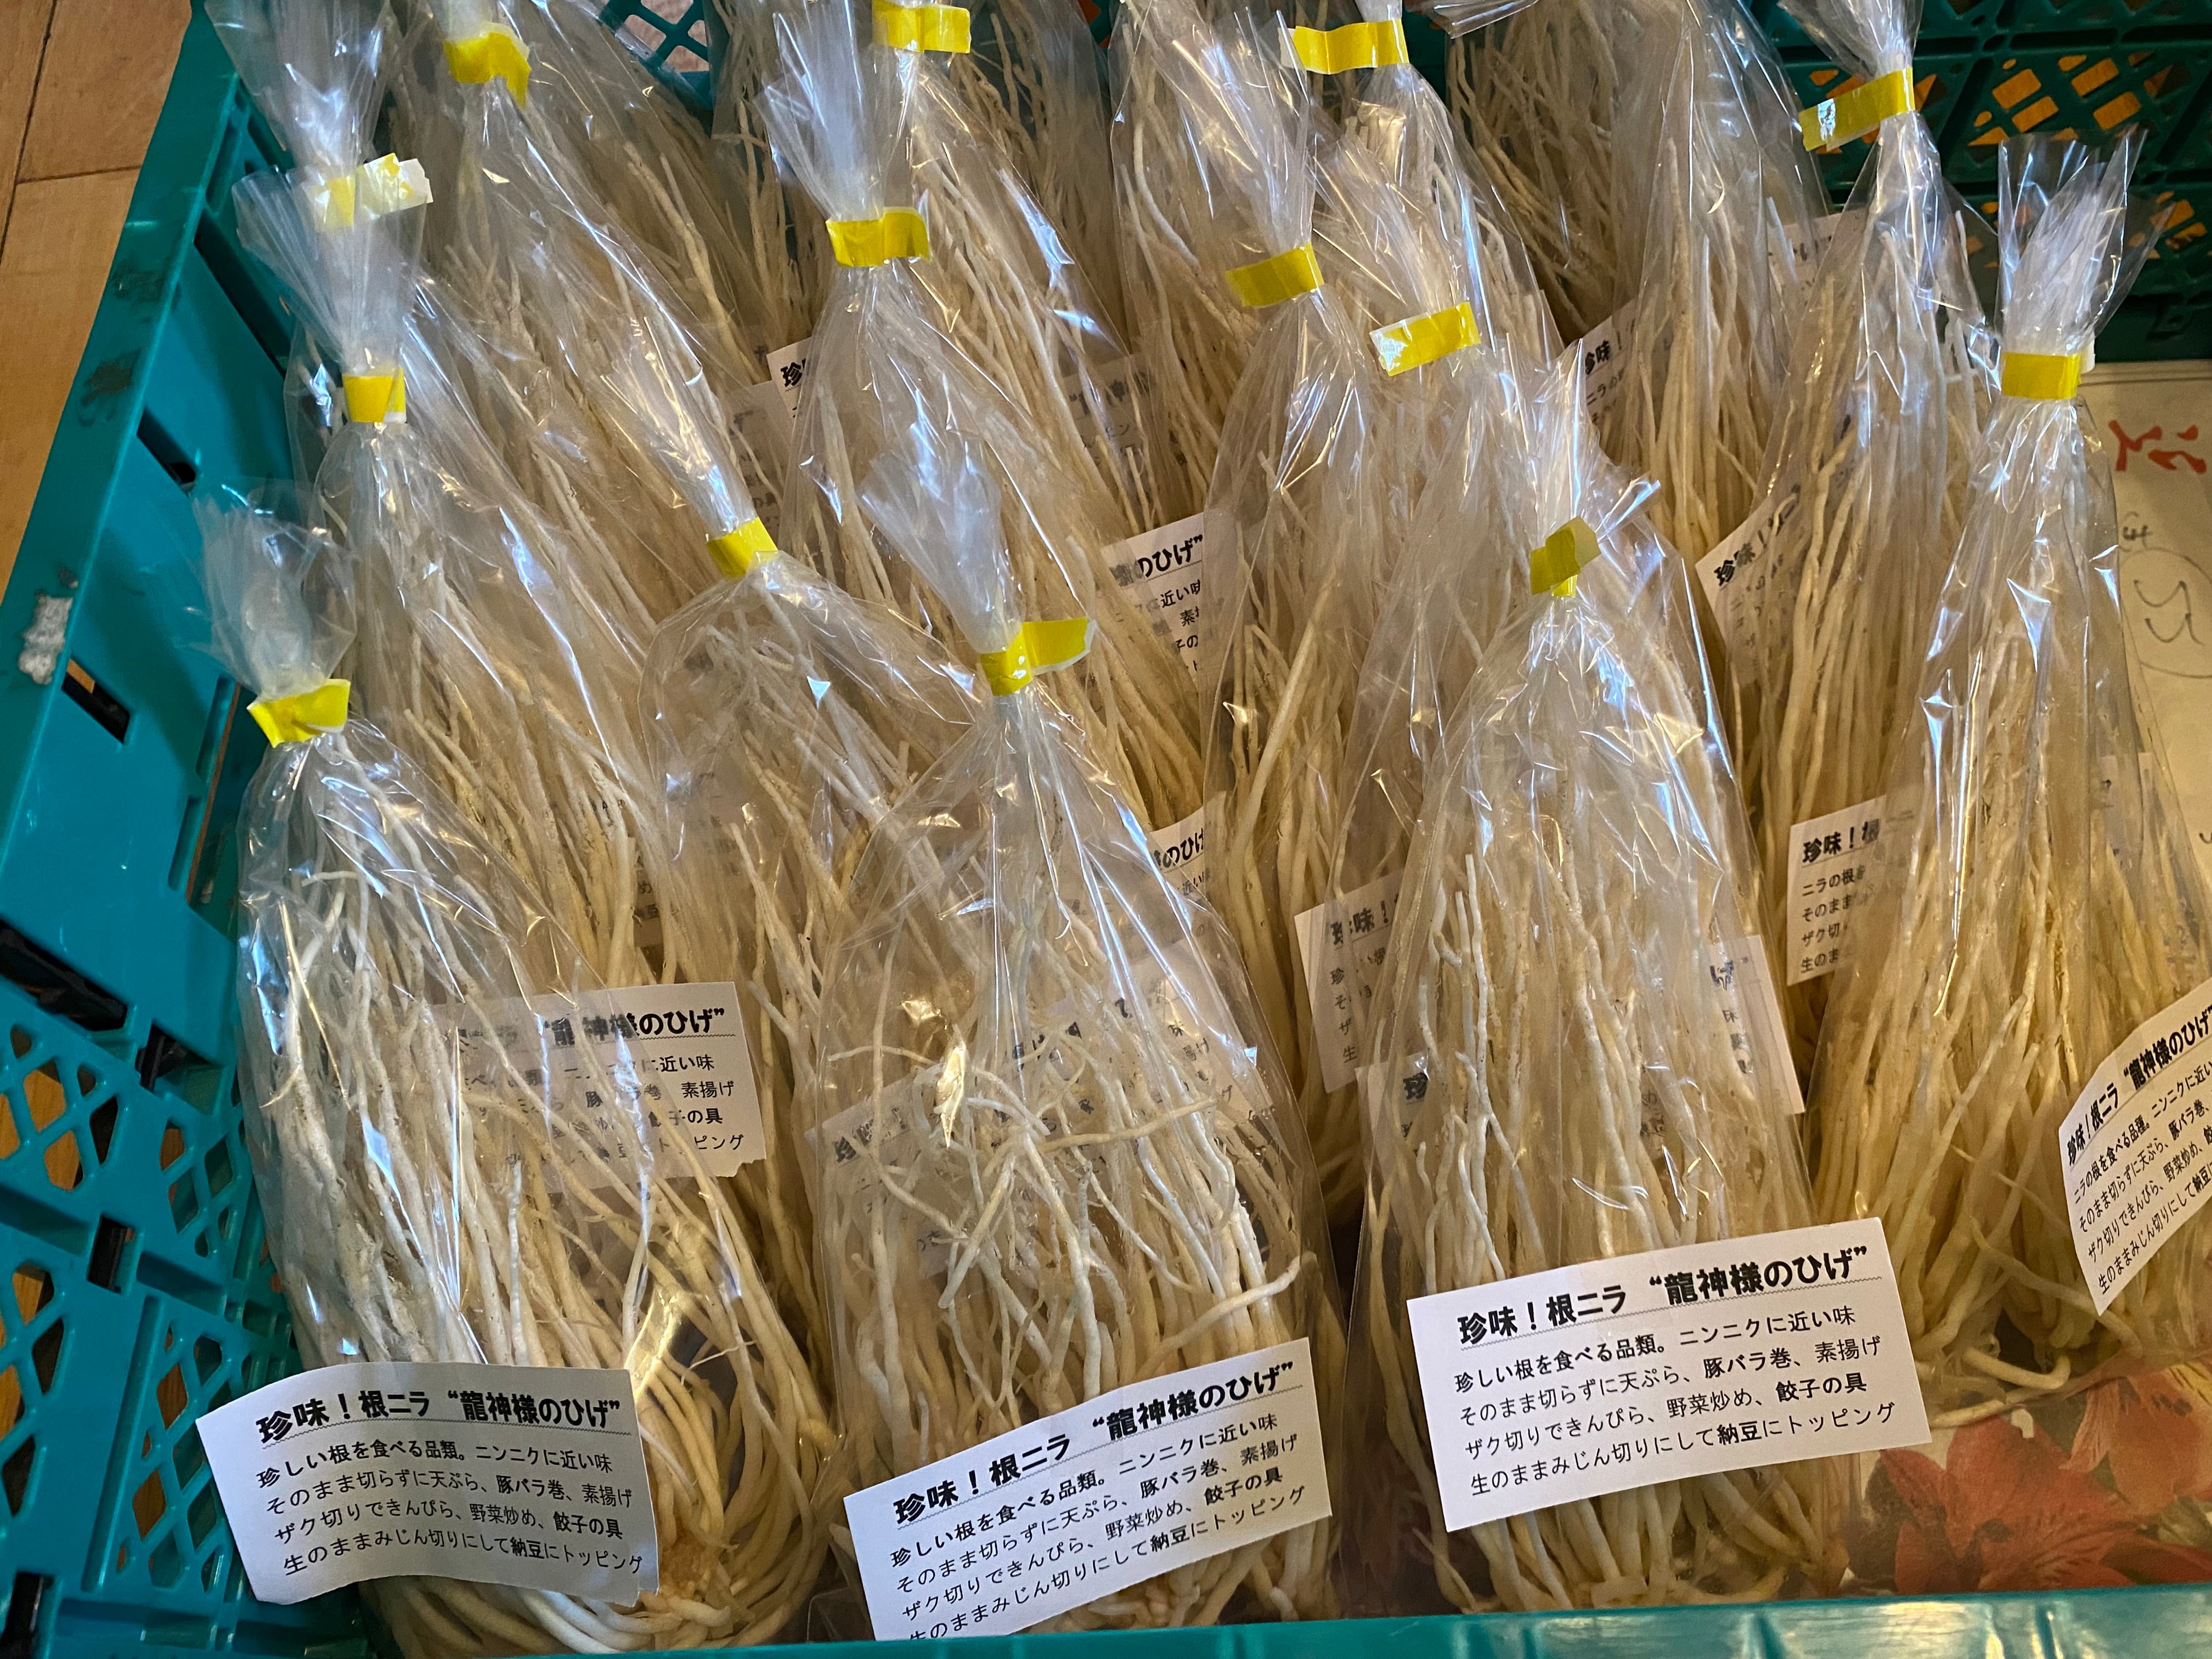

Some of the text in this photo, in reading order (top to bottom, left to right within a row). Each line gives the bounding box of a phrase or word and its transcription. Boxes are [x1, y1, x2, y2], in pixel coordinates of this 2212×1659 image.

[681, 1080, 734, 1098] 素揚げ
[1458, 1246, 1868, 1345] 珍味！根ニラ “龍神様のひげ”
[255, 1390, 621, 1444] 珍味！根ニラ “龍神様のひげ”
[1460, 1336, 1881, 1426] そのまま切らずに天ぷら、豚バラ巻、素揚げ
[1465, 1372, 1867, 1461] ザク切りできんぴら、野菜炒め、餃子の具
[893, 1362, 1293, 1526] 珍味！根ニラ “龍神様のひげ”
[1471, 1402, 1895, 1496] 生のままみじん切りにして納豆にトッピング
[267, 1470, 632, 1514] そのまま切らずに天ぷら、豚バラ巻、素揚げ
[275, 1499, 623, 1544] ザク切りできんぴら、野菜炒め、餃子の具
[897, 1434, 1297, 1593] そのまま切らずに天ぷら、豚バラ巻、素揚げ
[284, 1528, 643, 1575] 生のままみじん切りにして納豆にトッピング
[902, 1466, 1283, 1621] ザク切りできんぴら、野菜炒め、餃子の具
